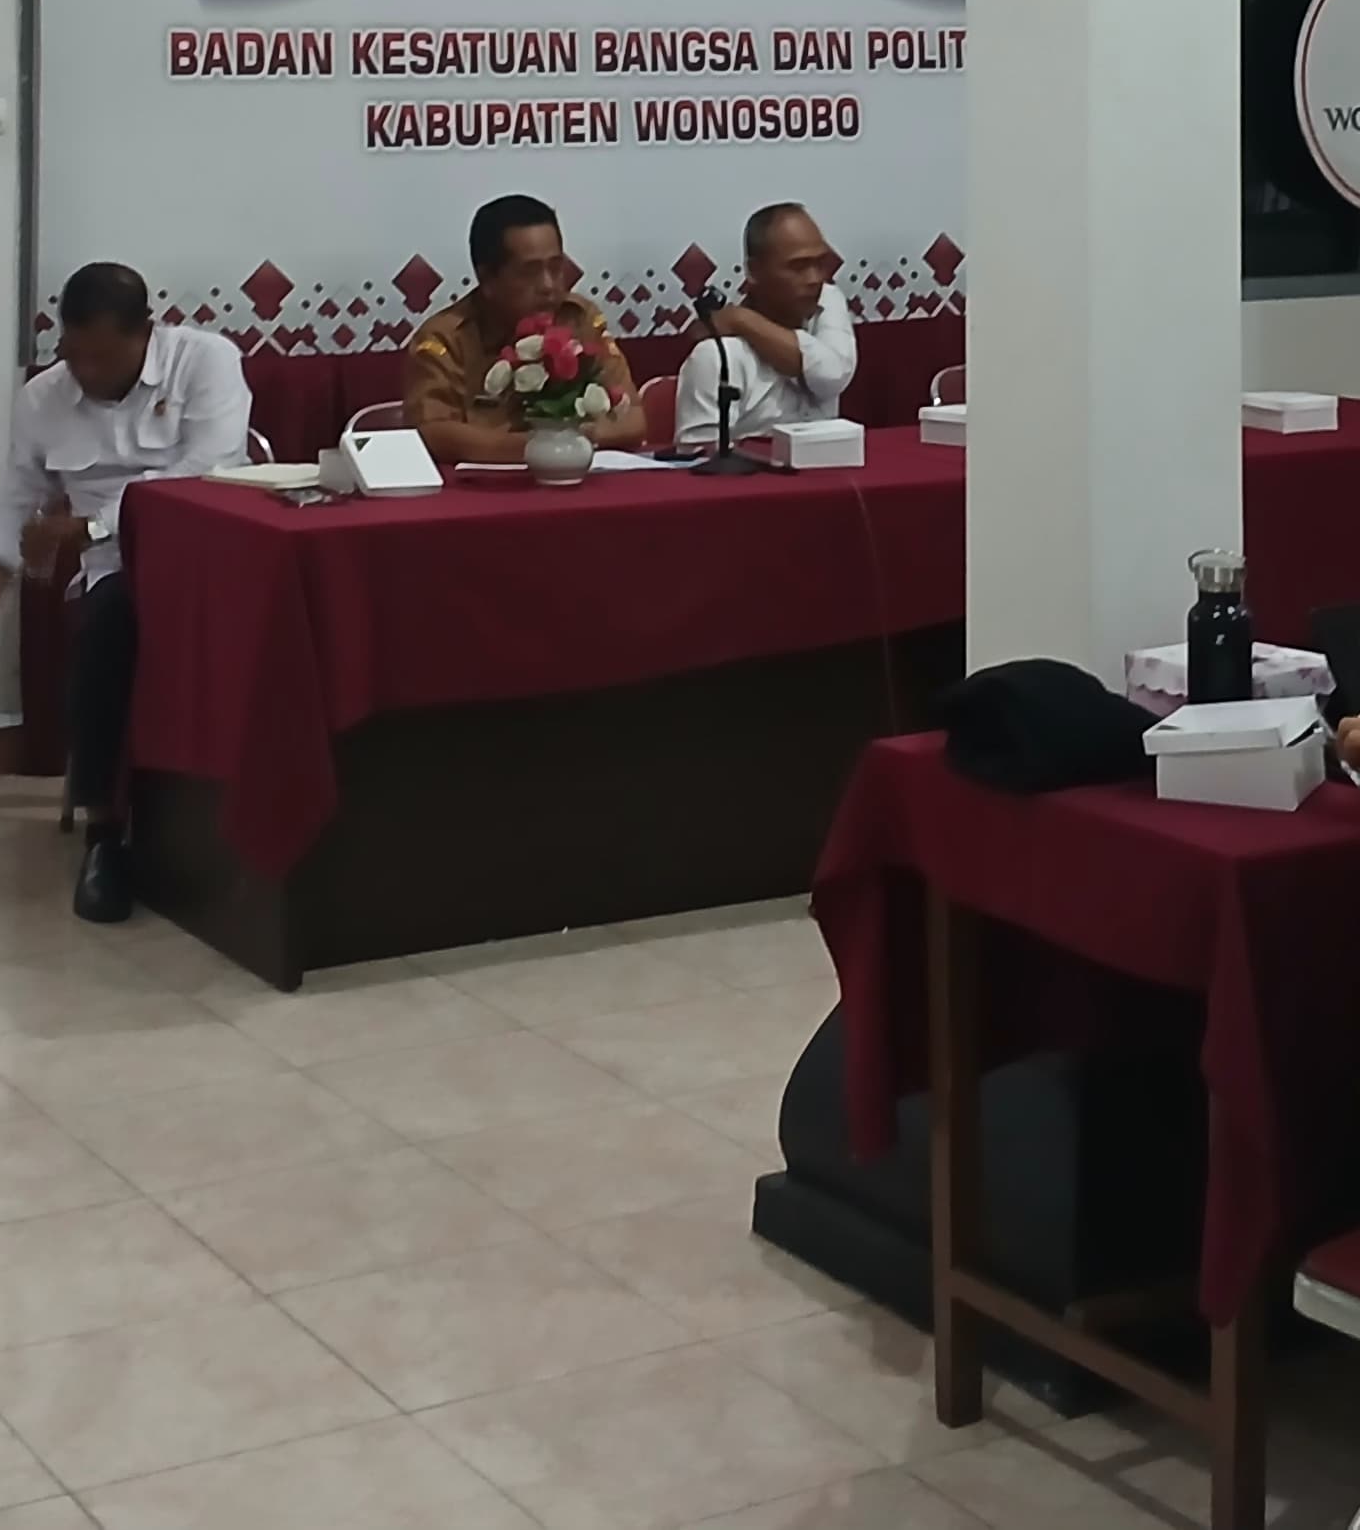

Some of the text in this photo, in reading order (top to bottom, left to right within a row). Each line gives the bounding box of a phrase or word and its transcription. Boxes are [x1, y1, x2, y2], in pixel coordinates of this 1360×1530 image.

[169, 29, 967, 76] BADAN KESATUAN BANGSA DAN POLIT
[366, 97, 860, 148] KABUPATEN WONOSOBO
